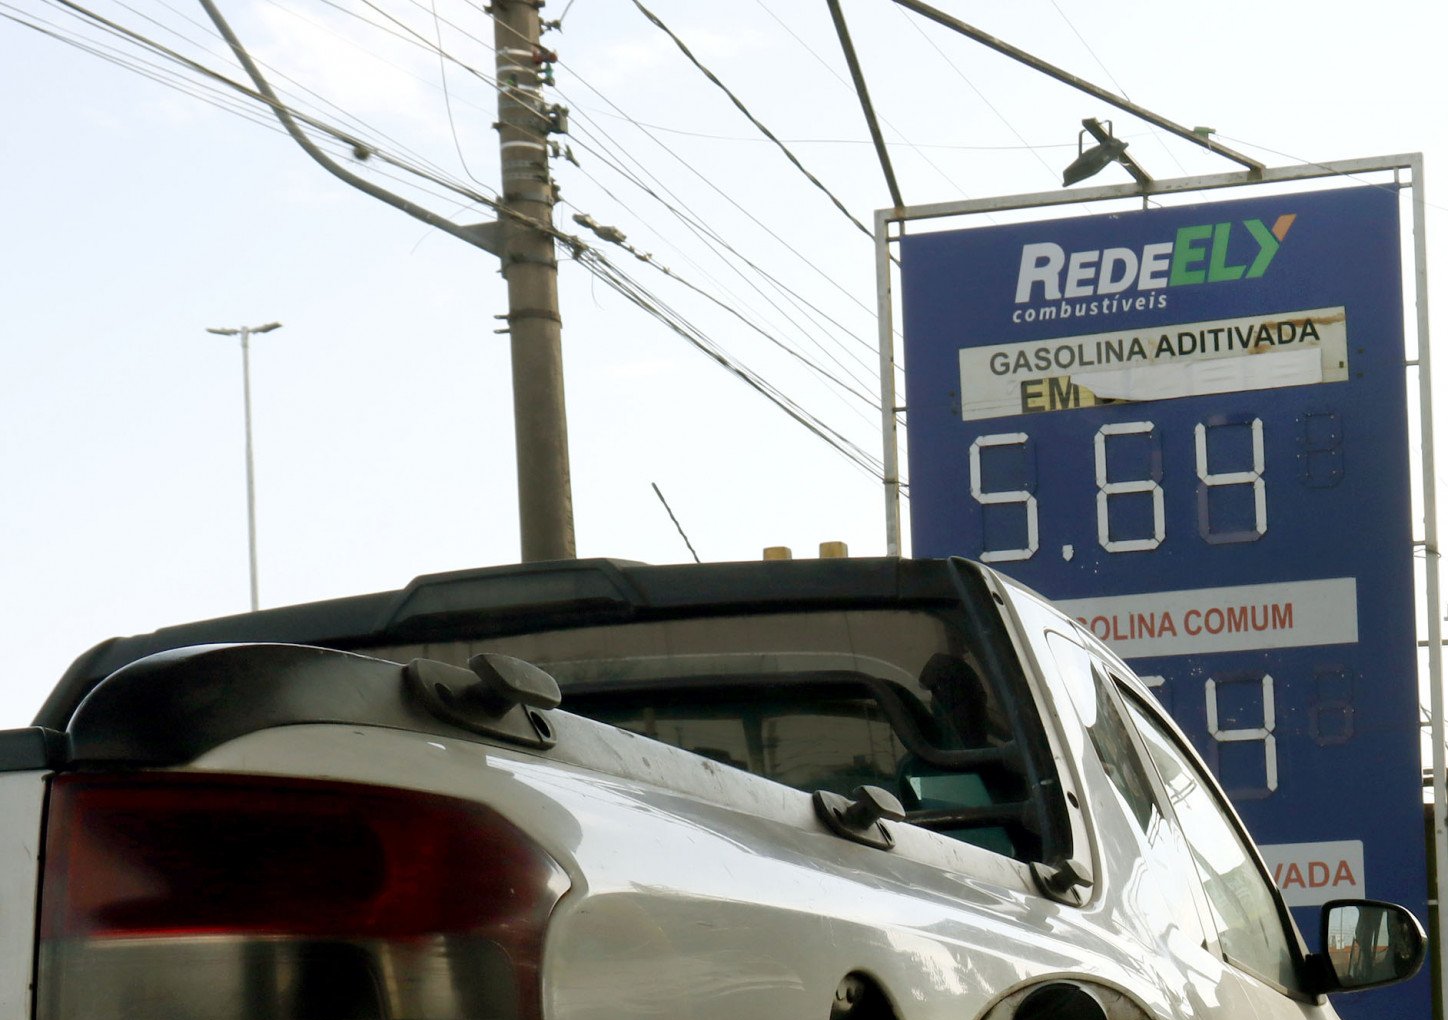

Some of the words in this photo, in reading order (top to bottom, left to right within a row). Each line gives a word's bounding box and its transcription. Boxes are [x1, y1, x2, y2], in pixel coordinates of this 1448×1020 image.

[1013, 291, 1168, 324] combustíveis
[989, 336, 1147, 378] GASOLINA
[1154, 317, 1321, 359] ADITIVADA
[1184, 602, 1294, 636] COMUM
